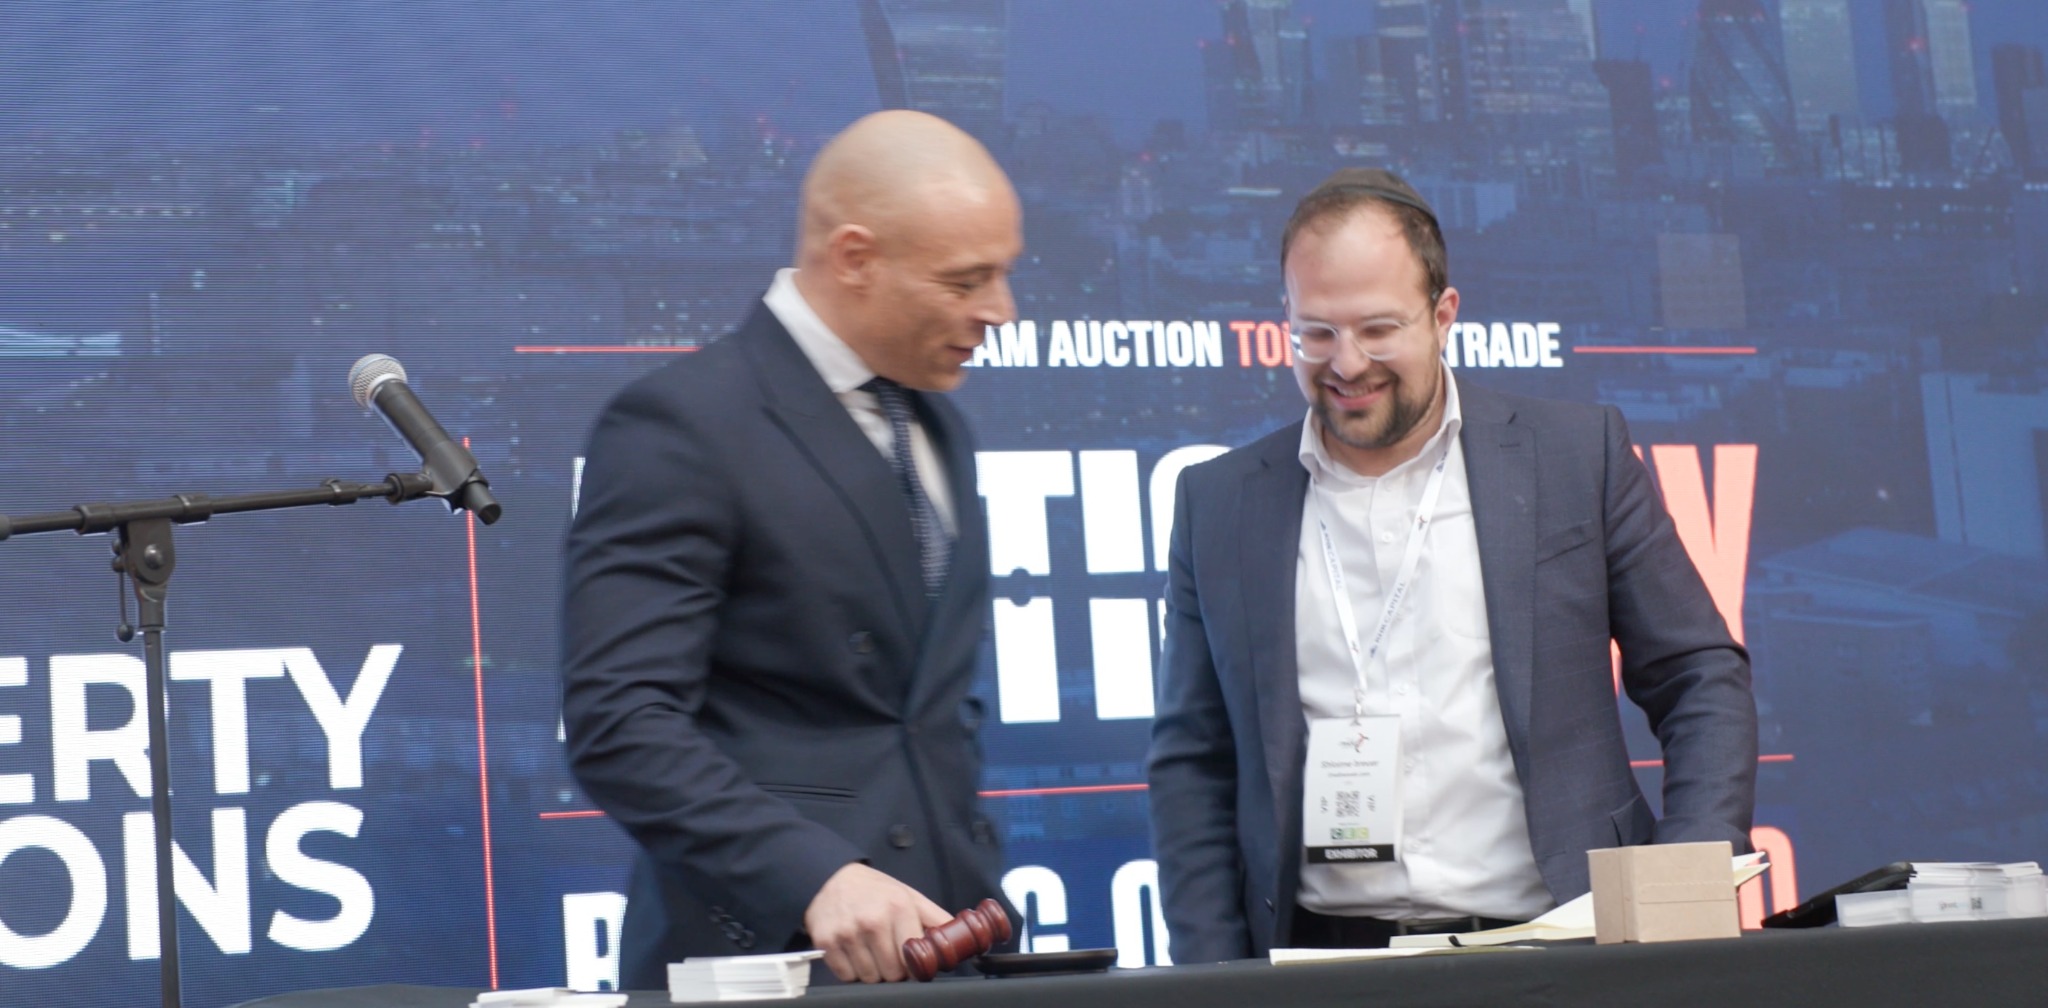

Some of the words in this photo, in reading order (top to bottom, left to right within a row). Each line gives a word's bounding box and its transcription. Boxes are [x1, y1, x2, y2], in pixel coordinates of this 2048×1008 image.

[960, 320, 1039, 367] AM
[1048, 320, 1223, 367] AUCTION
[1446, 322, 1563, 368] TRADE
[1324, 848, 1378, 860] EXHIBITOR
